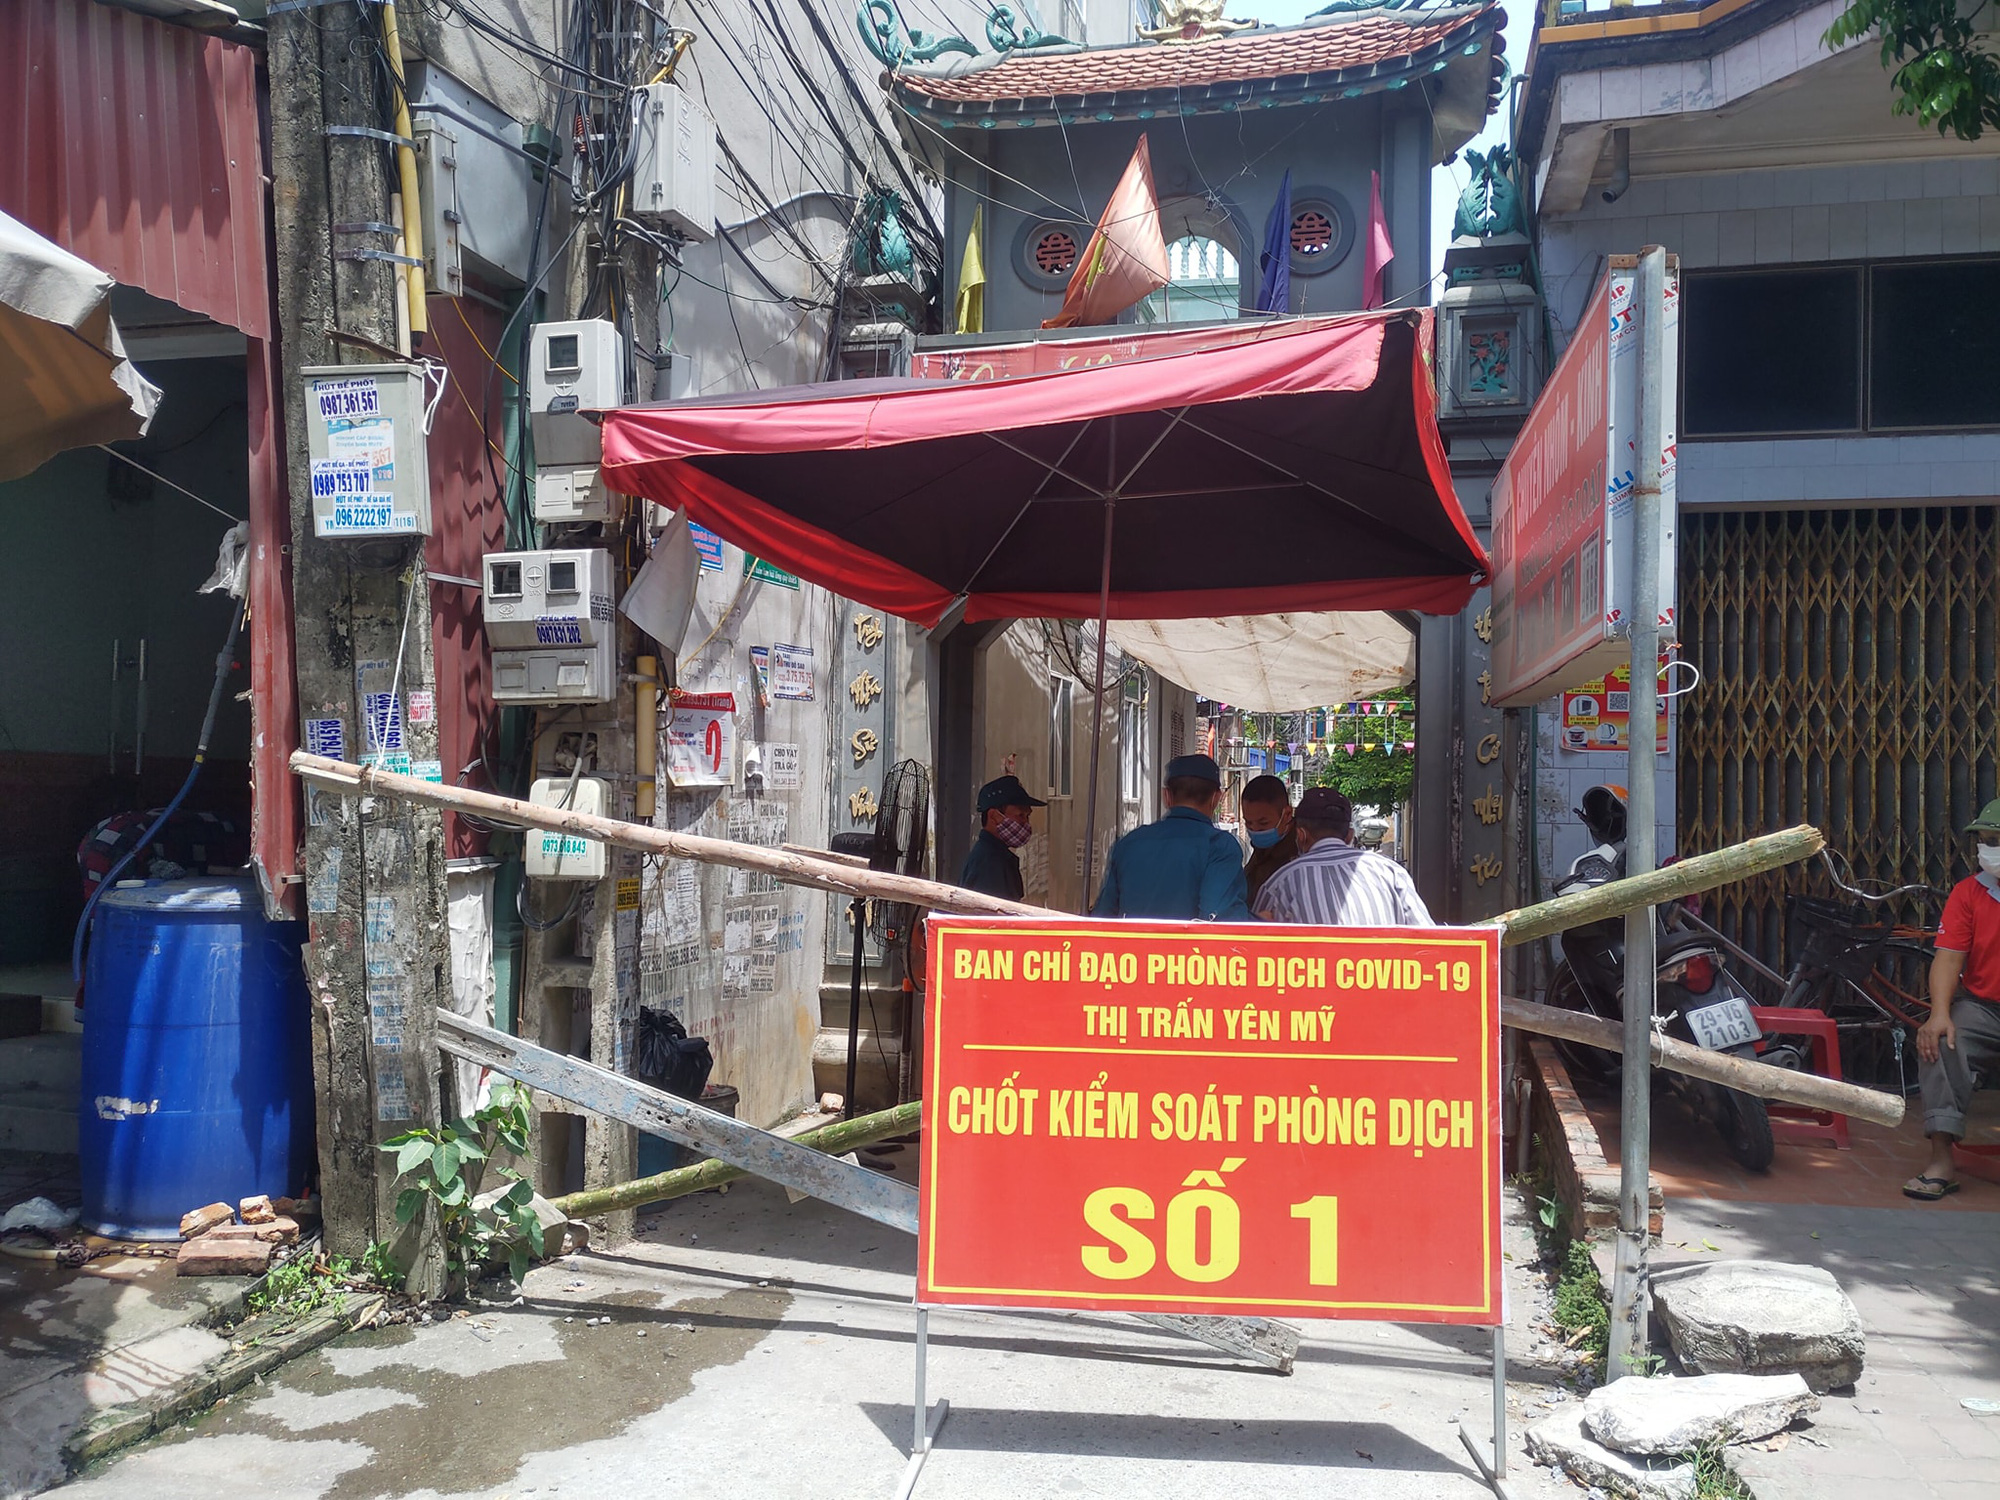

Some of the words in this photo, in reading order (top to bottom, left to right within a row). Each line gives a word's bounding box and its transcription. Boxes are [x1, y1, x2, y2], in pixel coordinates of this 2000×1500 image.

[350, 377, 375, 388] PHỐT
[320, 390, 378, 416] 0987.361.567
[1544, 391, 1569, 500] NHÔM
[1577, 332, 1603, 453] KÍNH
[1575, 459, 1603, 528] LOẠI
[335, 508, 391, 526] 096.2222.197
[774, 748, 785, 758] CHO
[786, 748, 798, 758] VAY
[774, 759, 785, 771] TRẢ
[955, 949, 1013, 980] BAN
[1023, 941, 1071, 981] CHỈ
[1079, 951, 1137, 989] ĐẠO
[1148, 945, 1247, 987] PHÒNG
[1257, 957, 1326, 995] DỊCH
[1336, 959, 1470, 992] COVID-19
[1083, 1004, 1127, 1044] THỊ
[1137, 996, 1214, 1039] TRẤN
[1223, 1003, 1280, 1041] YÊN
[1291, 1005, 1336, 1042] MỸ
[1696, 1003, 1743, 1030] 29-V6
[1704, 1020, 1751, 1048] 2103
[948, 1071, 1039, 1136] CHỐT
[1049, 1071, 1139, 1139] KIỂM
[1151, 1084, 1243, 1143] SOÁT
[1254, 1085, 1377, 1146] PHÒNG
[1389, 1098, 1474, 1158] DỊCH
[1081, 1157, 1247, 1283] SỐ
[1291, 1196, 1338, 1287] 1
